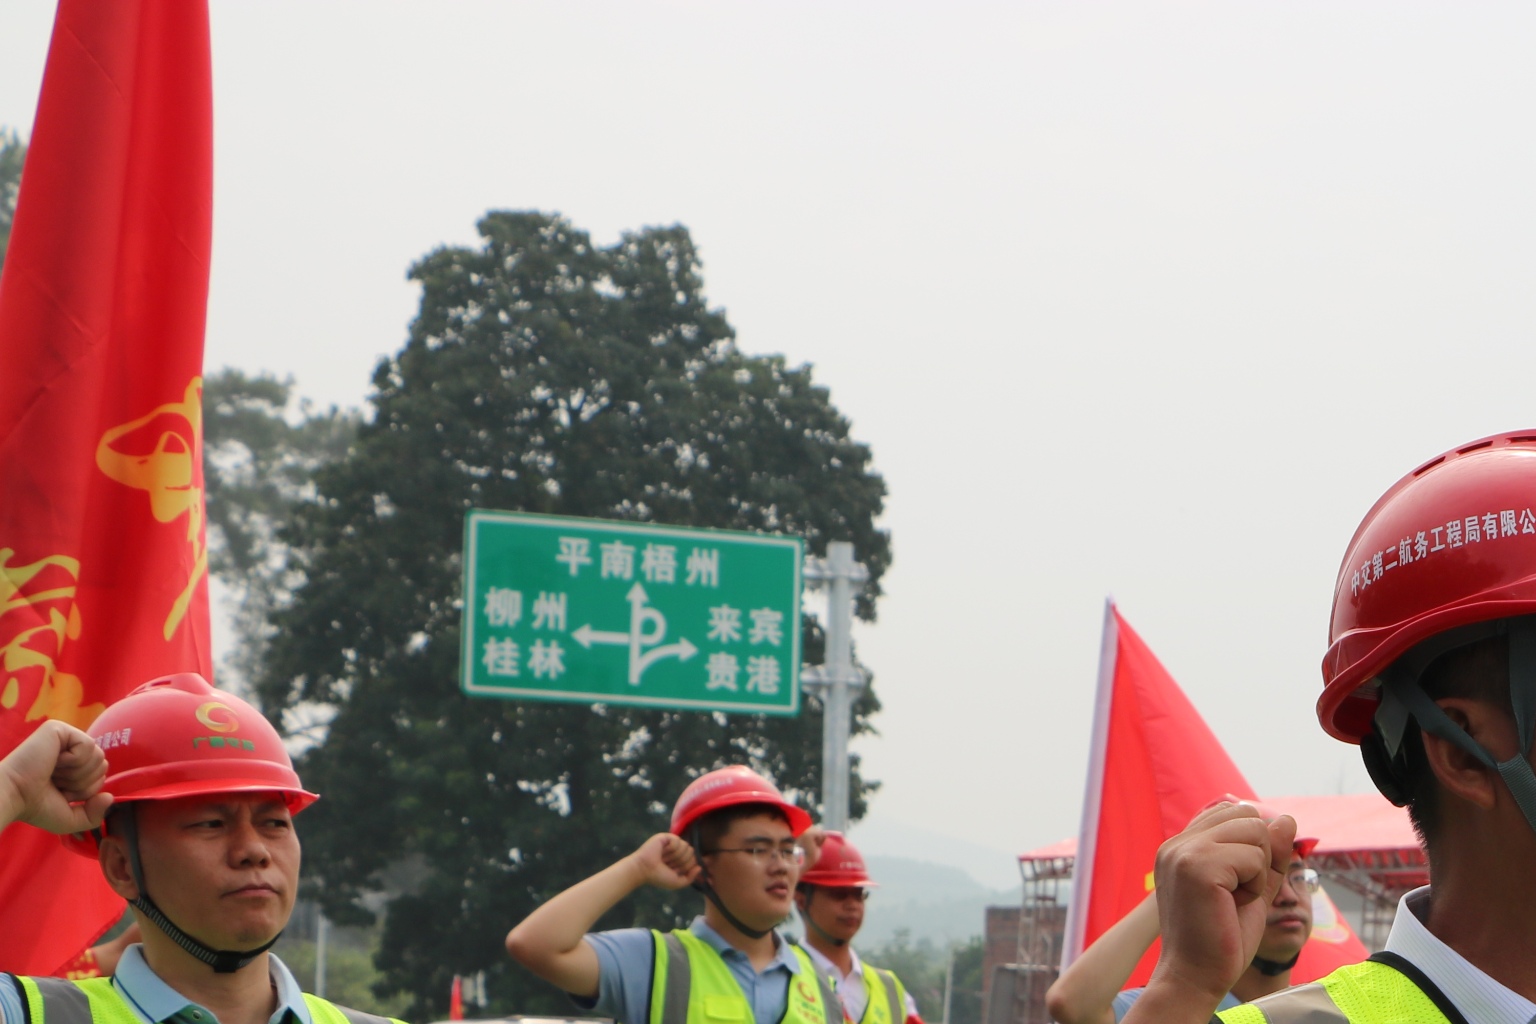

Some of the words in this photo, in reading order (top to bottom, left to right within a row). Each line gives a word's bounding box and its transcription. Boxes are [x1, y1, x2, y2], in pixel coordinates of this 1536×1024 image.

[555, 536, 720, 588] 平南梧州
[483, 586, 568, 632] 柳州
[706, 604, 785, 647] 来宾
[481, 636, 567, 680] 桂林
[705, 651, 782, 694] 贵港
